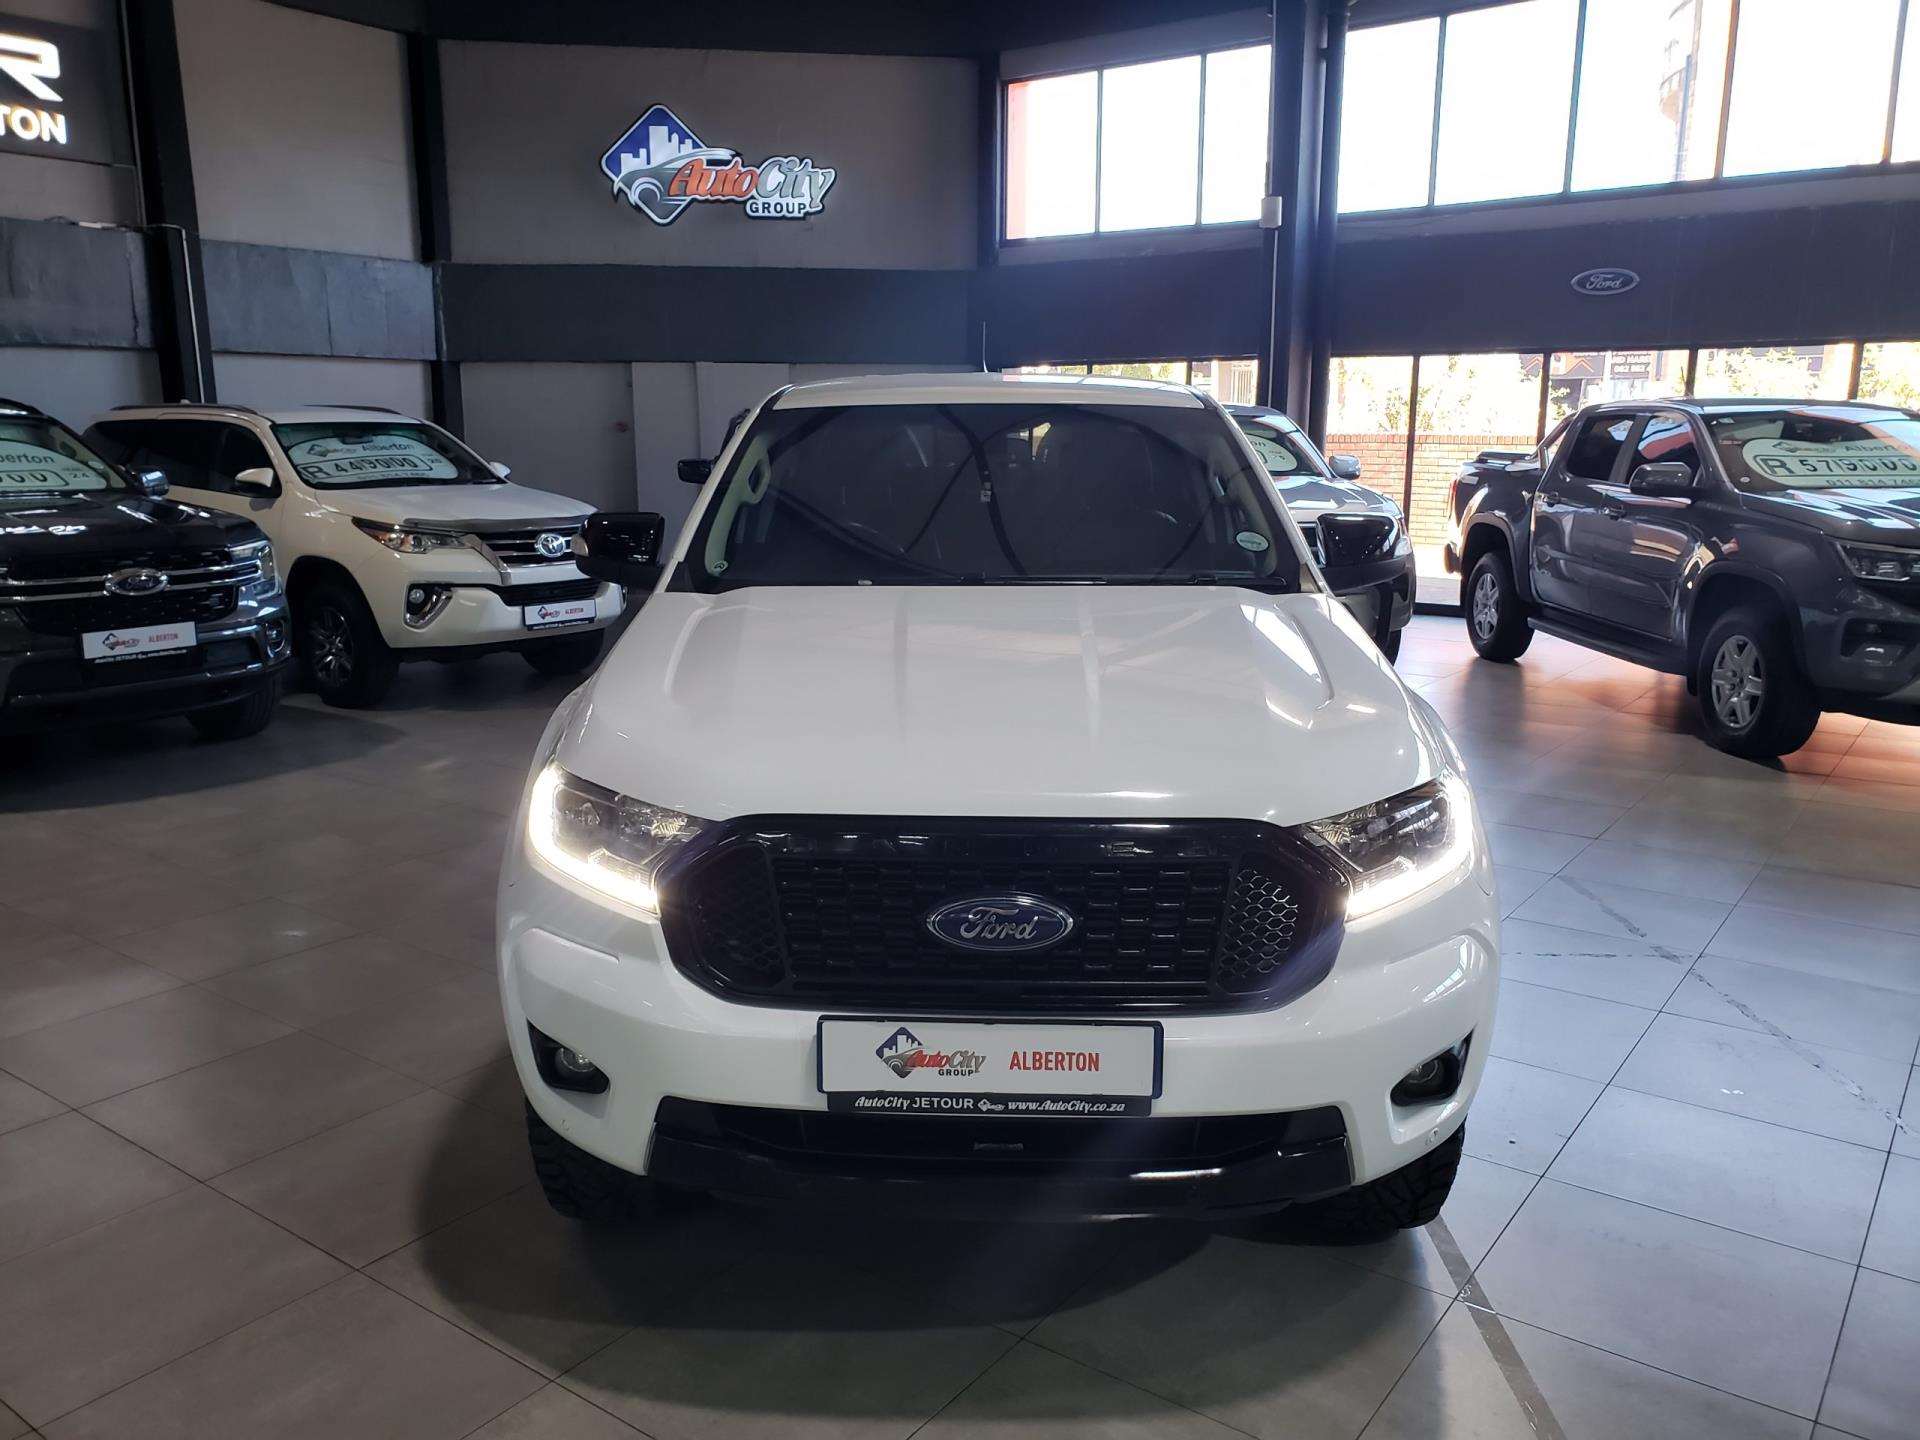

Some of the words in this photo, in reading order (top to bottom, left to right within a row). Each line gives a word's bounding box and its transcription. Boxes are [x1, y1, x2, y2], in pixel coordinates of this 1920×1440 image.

[668, 158, 833, 208] AutoCity
[749, 202, 807, 215] GROUP
[1585, 272, 1625, 290] Ford
[301, 465, 331, 479] R
[334, 457, 418, 473] 449000
[1760, 457, 1795, 474] R
[960, 906, 1039, 940] Ford
[906, 1050, 987, 1073] AutoCity
[1009, 1051, 1101, 1072] ALBERTON
[938, 1068, 975, 1077] GROUP
[854, 1096, 911, 1110] AutoCity
[912, 1097, 975, 1109] JETOUR
[1008, 1100, 1126, 1113] www.AutoCity.co.za
